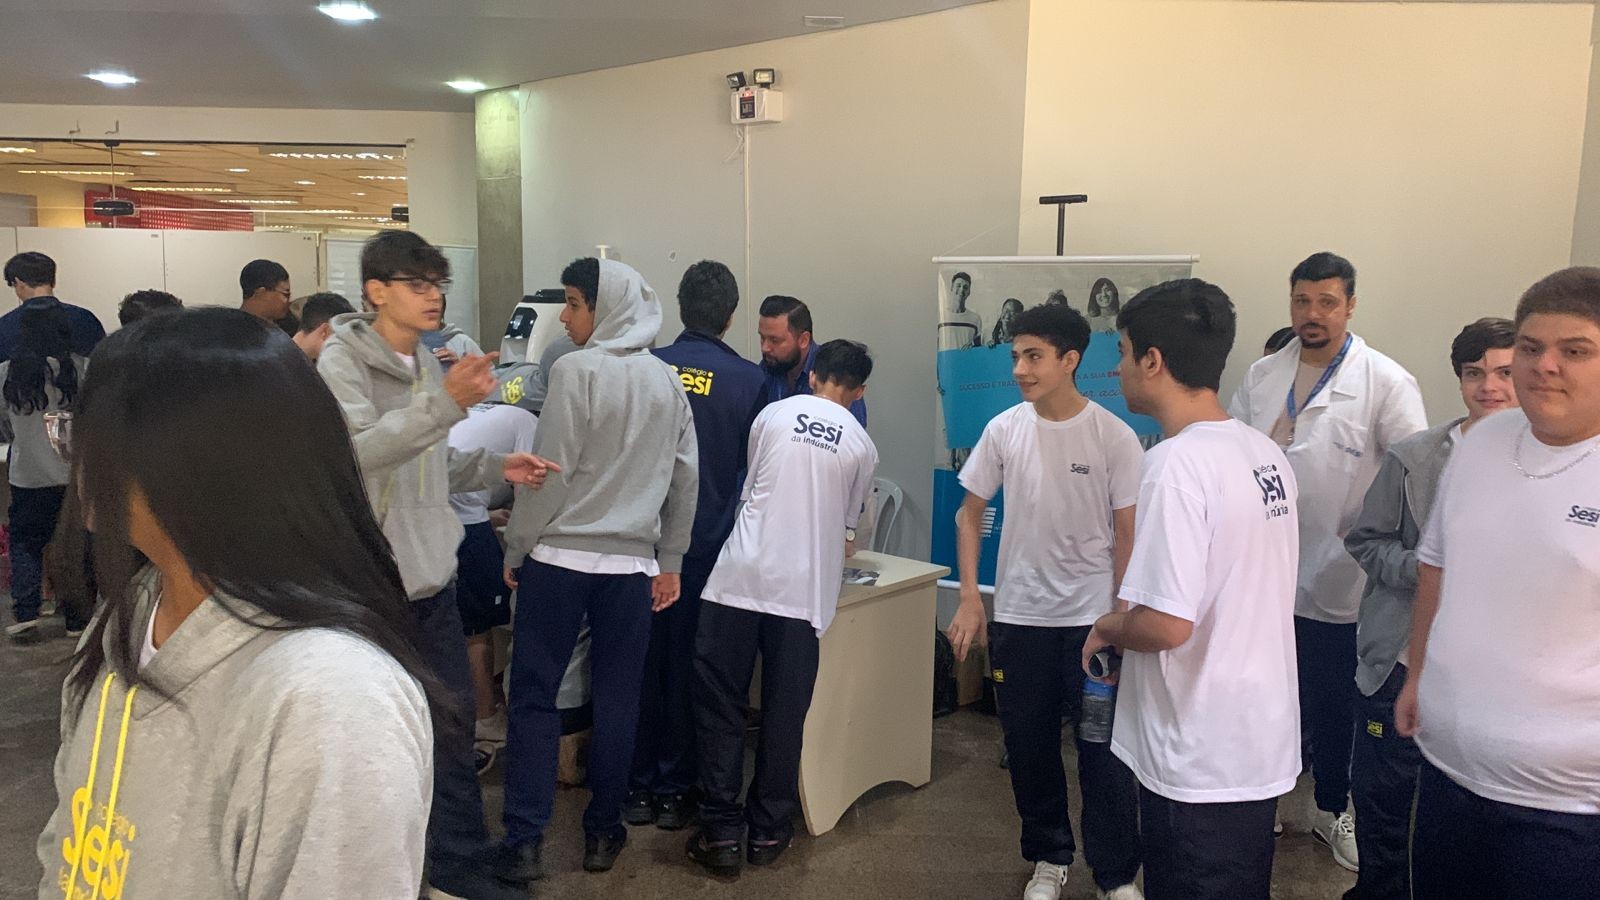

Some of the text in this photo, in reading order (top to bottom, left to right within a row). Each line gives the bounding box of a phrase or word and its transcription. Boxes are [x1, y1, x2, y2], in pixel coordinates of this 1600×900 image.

[670, 364, 714, 396] esi
[794, 413, 844, 446] Sesi
[803, 436, 838, 454] indústria
[1568, 505, 1600, 523] Sesi
